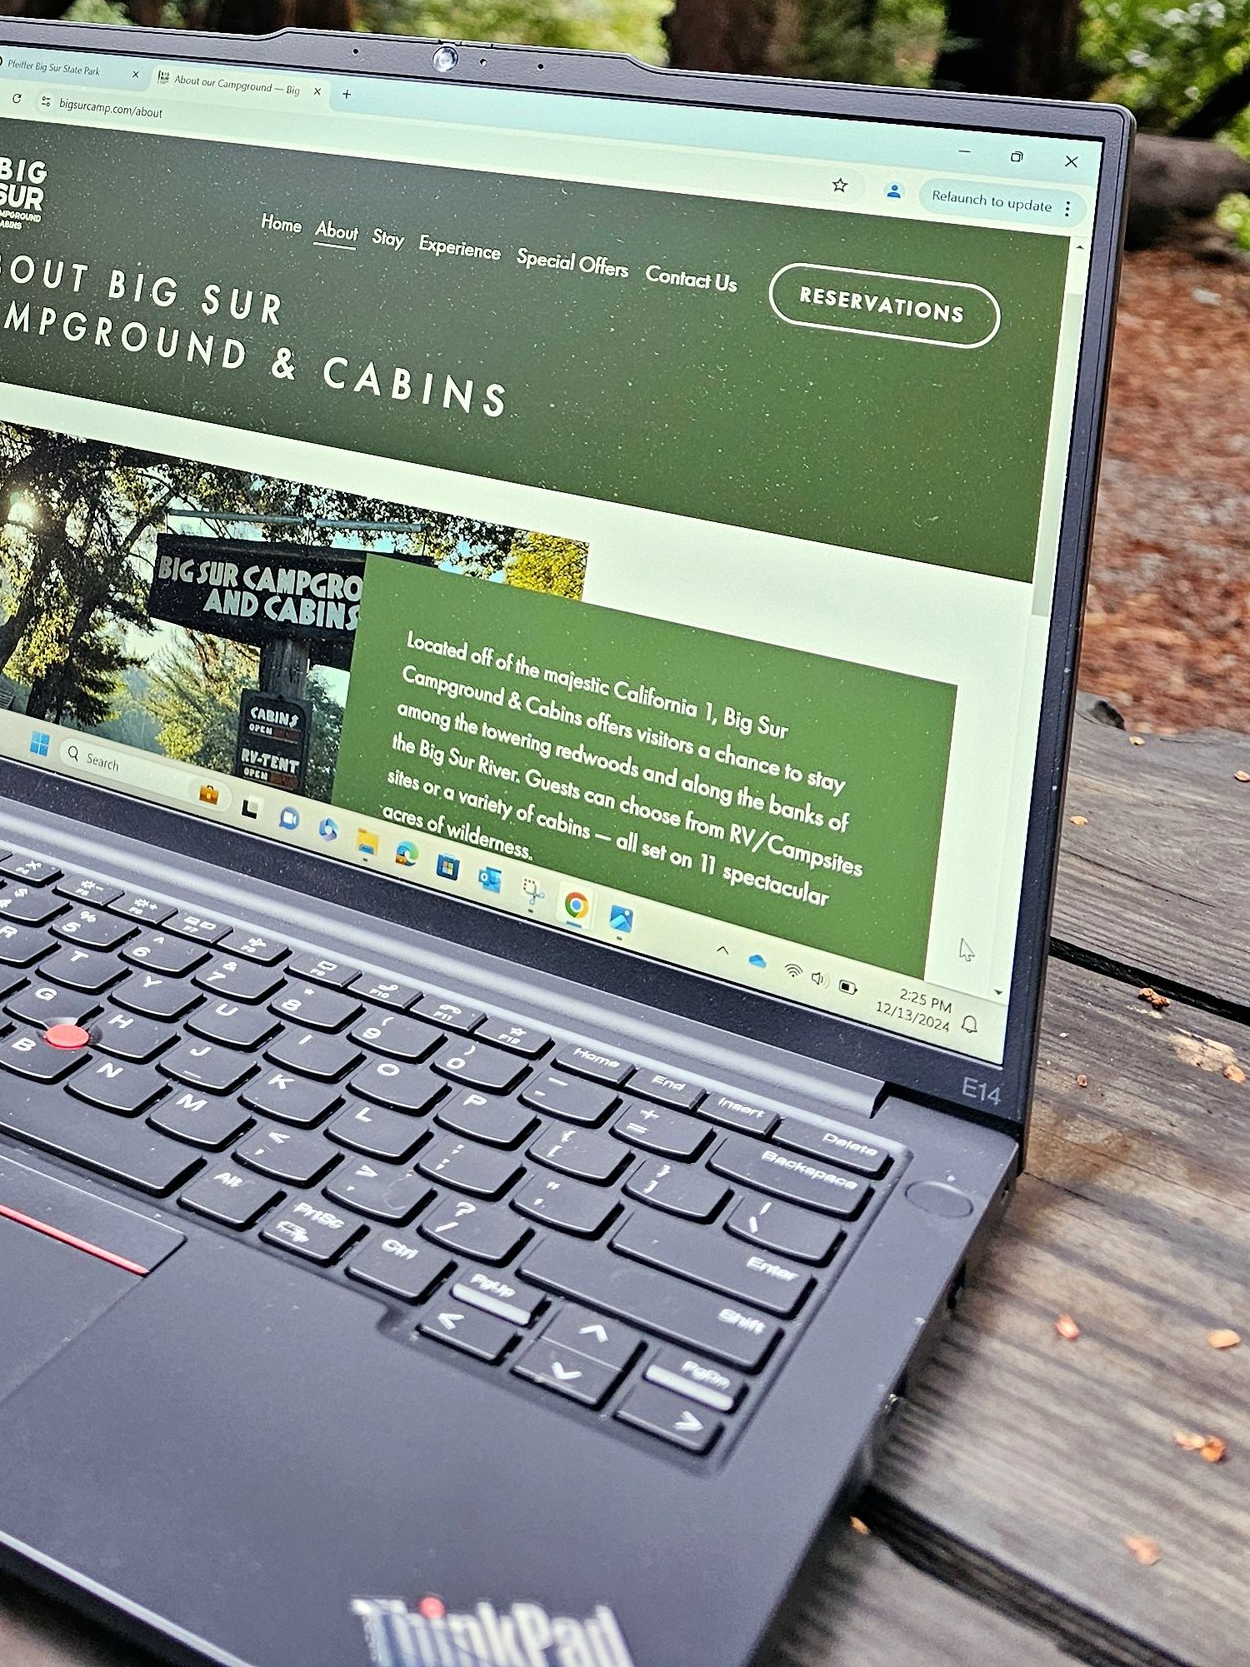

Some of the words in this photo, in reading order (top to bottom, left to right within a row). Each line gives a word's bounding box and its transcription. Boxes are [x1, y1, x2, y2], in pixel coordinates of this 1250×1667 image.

[7, 59, 34, 70] Pfeiffer
[35, 62, 47, 73] Big
[50, 64, 62, 73] Sur
[63, 64, 82, 74] State
[83, 66, 100, 76] Park
[174, 75, 200, 86] About
[202, 78, 216, 87] our
[217, 78, 272, 92] Campground
[286, 85, 300, 97] Big
[59, 97, 163, 119] bigsurcamp.com/about
[932, 189, 988, 207] Relaunch
[991, 196, 1004, 208] to
[1007, 196, 1053, 214] update
[261, 213, 303, 234] Home
[315, 220, 359, 241] About
[372, 228, 405, 251] Stay
[418, 234, 502, 262] Experience
[517, 248, 575, 272] Special
[579, 255, 629, 278] Offers
[645, 265, 712, 290] Contact
[715, 273, 738, 294] Us
[108, 269, 178, 308] BIG
[201, 283, 281, 326] SUR
[799, 286, 964, 323] RESERVATIONS
[271, 347, 296, 381] &
[323, 356, 506, 418] CABINS
[158, 555, 195, 584] BIG
[197, 559, 239, 588] SUR
[202, 588, 259, 618] AND
[264, 595, 360, 631] CABINS
[407, 629, 468, 661] Located
[470, 646, 495, 667] off
[495, 652, 514, 672] of
[515, 656, 540, 678] the
[543, 668, 610, 696] majestic
[614, 680, 698, 718] California
[705, 702, 718, 726] 1,
[723, 706, 753, 736] Big
[757, 715, 789, 740] Sur
[248, 723, 273, 736] OPEN
[250, 706, 300, 728] CABINS
[402, 665, 505, 707] Campground
[507, 691, 522, 711] &
[525, 696, 583, 726] Cabins
[586, 711, 633, 739] offers
[637, 727, 694, 755] visitors
[697, 745, 711, 759] a
[714, 743, 781, 777] chance
[784, 763, 804, 782] to
[807, 771, 847, 798] stay
[86, 752, 120, 773] Search
[241, 747, 300, 774] RV-TENT
[397, 703, 451, 732] among
[454, 711, 479, 735] the
[481, 722, 552, 759] towering
[555, 742, 639, 778] redwoods
[642, 767, 678, 789] and
[681, 773, 733, 807] along
[736, 785, 765, 811] the
[768, 792, 825, 828] banks
[828, 812, 851, 833] of
[243, 767, 268, 781] OPEN
[392, 731, 416, 754] the
[419, 738, 445, 767] Big
[448, 747, 476, 771] Sur
[478, 754, 521, 784] River.
[525, 768, 581, 800] Guests
[583, 788, 616, 810] can
[619, 794, 682, 827] choose
[685, 809, 725, 840] from
[730, 822, 864, 879] RV/Campsites
[382, 805, 424, 829] acres
[426, 814, 446, 834] of
[447, 821, 534, 862] wilderness.
[387, 769, 420, 792] sites
[422, 781, 442, 797] or
[443, 787, 455, 801] a
[458, 790, 514, 821] variety
[515, 803, 536, 823] of
[536, 811, 591, 840] cabins
[616, 831, 639, 853] all
[641, 841, 667, 862] set
[669, 852, 693, 869] on
[700, 853, 717, 876] 11
[722, 864, 830, 908] spectacular
[68, 950, 90, 964] T
[34, 987, 59, 1002] G
[141, 974, 163, 990] Y
[214, 1003, 239, 1018] U
[900, 988, 928, 1006] 2:25
[931, 997, 953, 1015] PM
[112, 1014, 135, 1030] H
[876, 1000, 951, 1033] 12/13/2024
[10, 1037, 35, 1053] B
[572, 1046, 621, 1070] Home
[96, 1062, 125, 1080] N
[267, 1073, 296, 1092] K
[650, 1074, 687, 1093] End
[463, 1094, 488, 1111] P
[962, 1075, 1002, 1106] E14
[176, 1094, 209, 1113] M
[355, 1107, 373, 1123] L
[717, 1096, 766, 1120] Insert
[822, 1133, 879, 1158] Delete
[214, 1172, 244, 1188] Alt
[761, 1150, 859, 1191] Backspace
[293, 1201, 345, 1230] PrtSc
[381, 1238, 419, 1260] Ctrl
[746, 1256, 800, 1282] Enter
[470, 1273, 517, 1299] PgUp
[717, 1307, 767, 1335] Shift
[681, 1360, 731, 1389] PgDn
